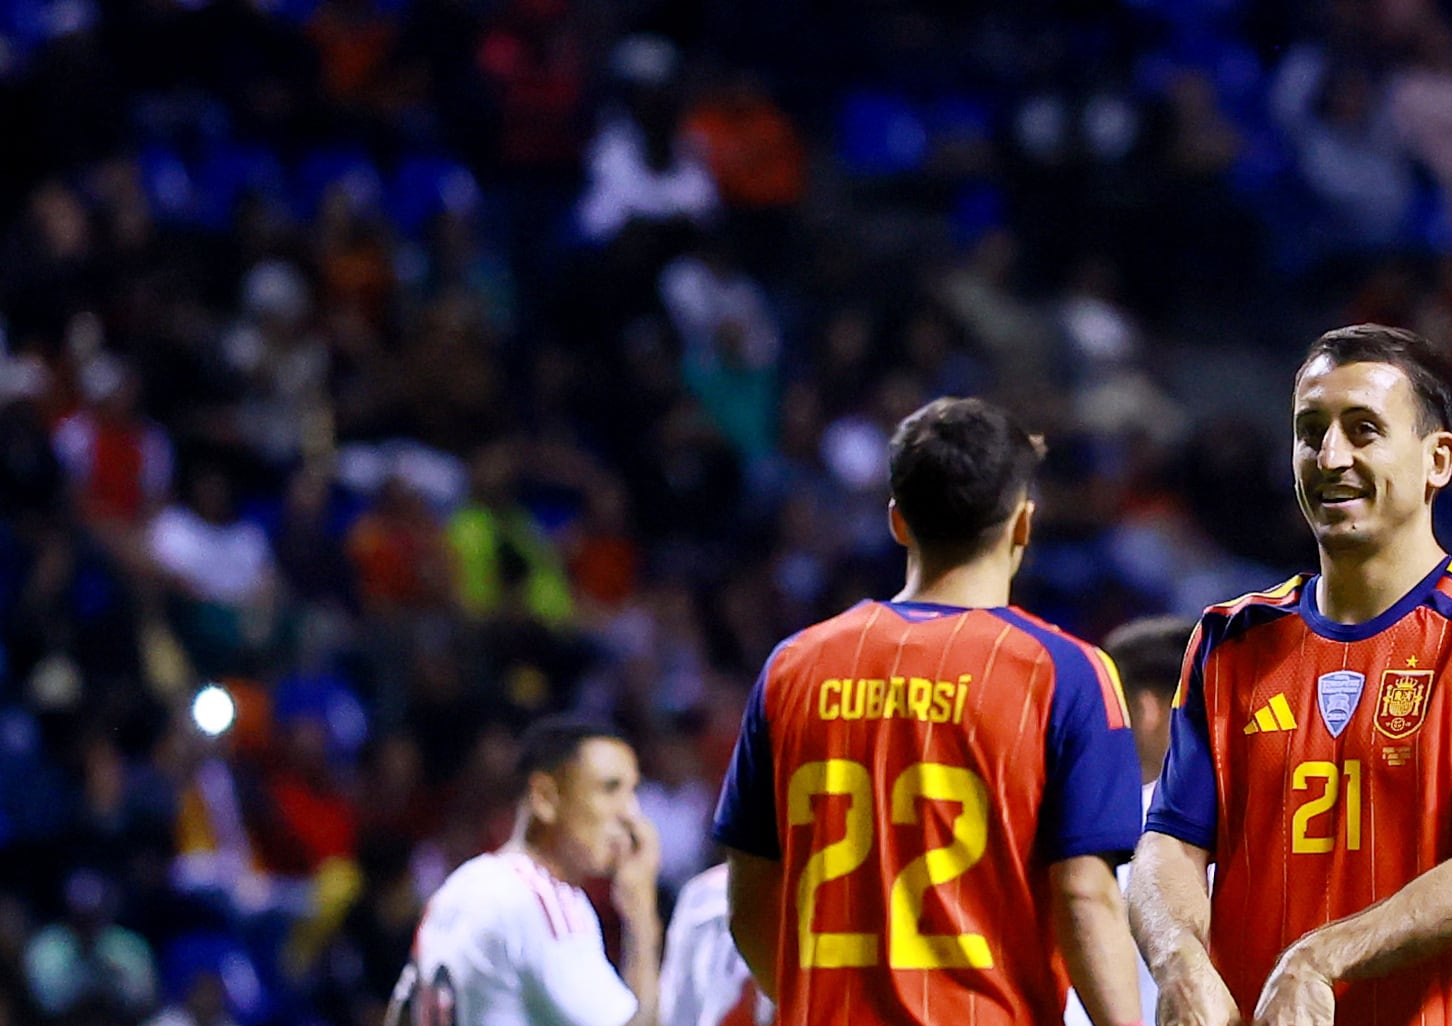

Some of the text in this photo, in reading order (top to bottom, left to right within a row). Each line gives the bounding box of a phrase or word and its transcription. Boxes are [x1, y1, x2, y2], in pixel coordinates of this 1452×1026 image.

[819, 674, 973, 725] CUBARSÍ
[1292, 759, 1361, 854] 21
[788, 758, 993, 970] 22
